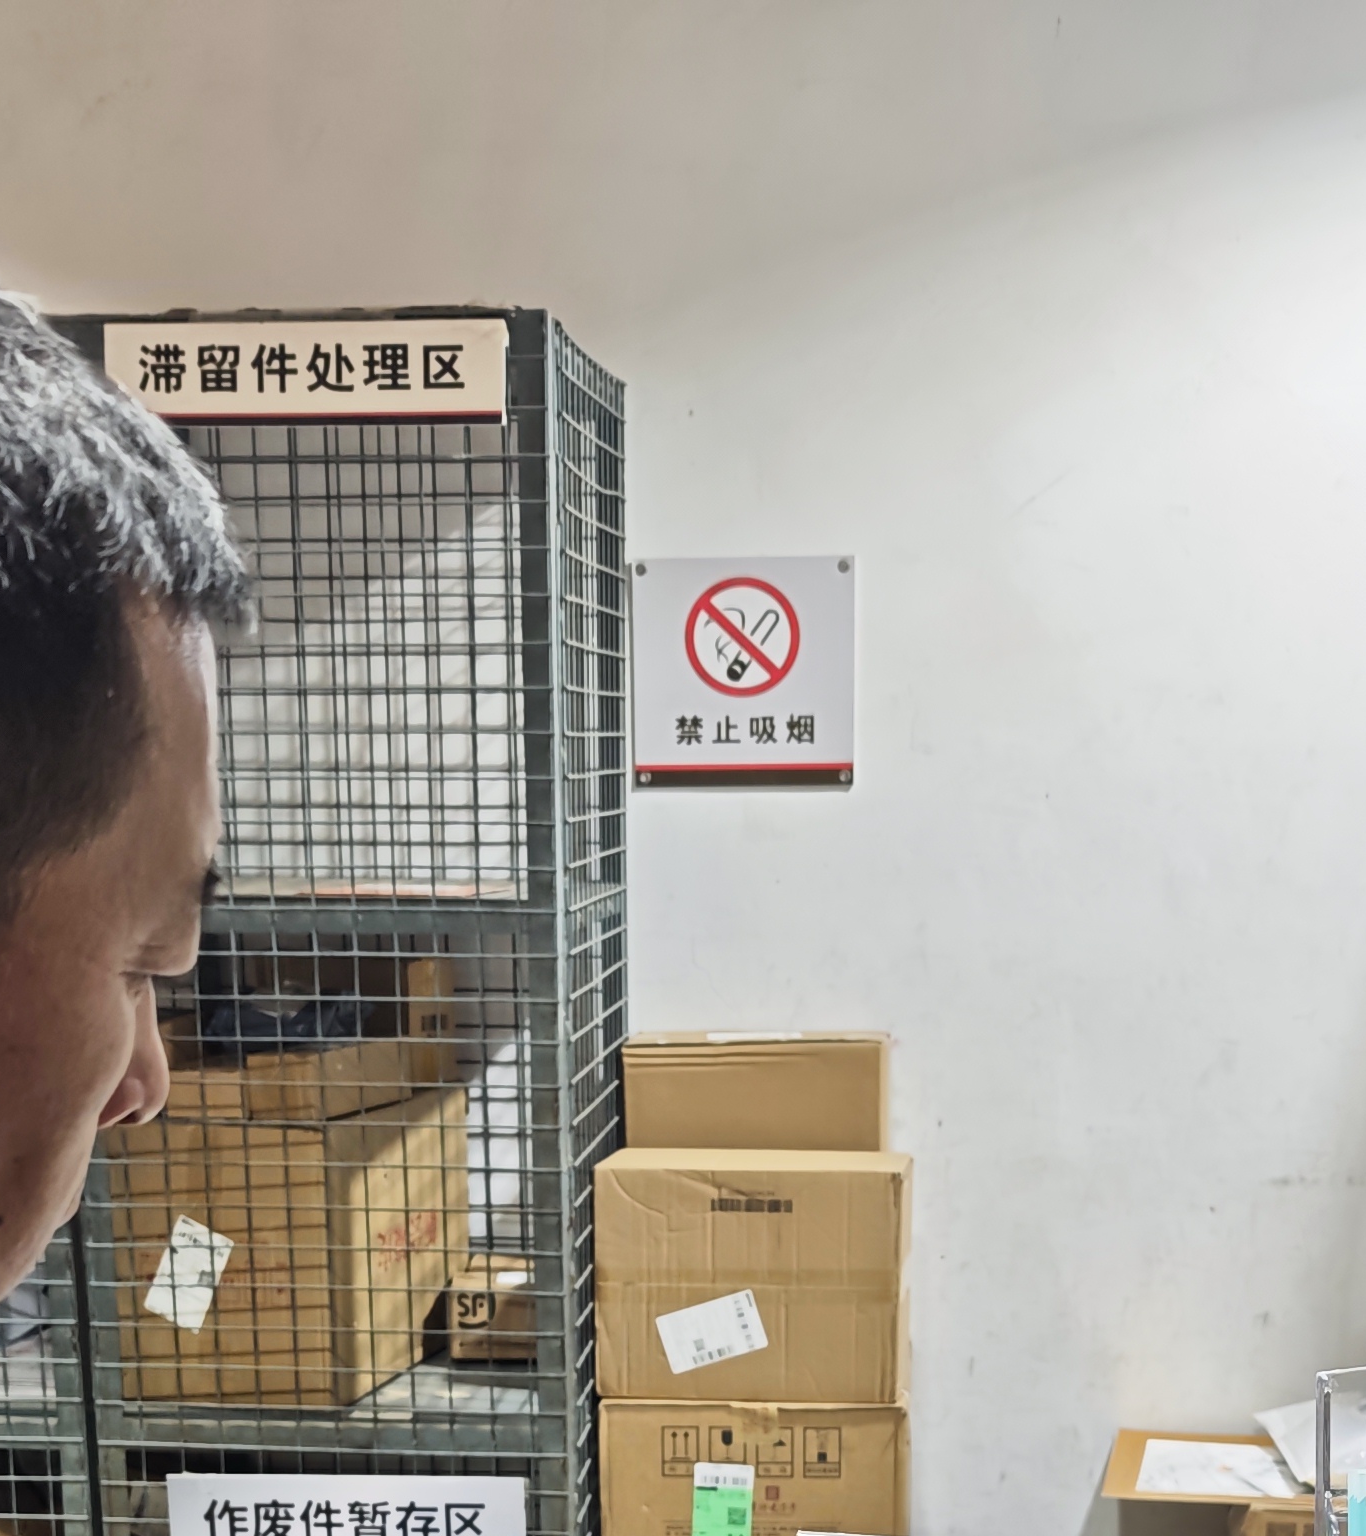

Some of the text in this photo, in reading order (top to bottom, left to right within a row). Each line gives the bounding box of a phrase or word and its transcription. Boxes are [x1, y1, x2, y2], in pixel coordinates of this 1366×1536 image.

[138, 343, 466, 394] 滞留件处理区
[674, 714, 816, 746] 禁止吸烟
